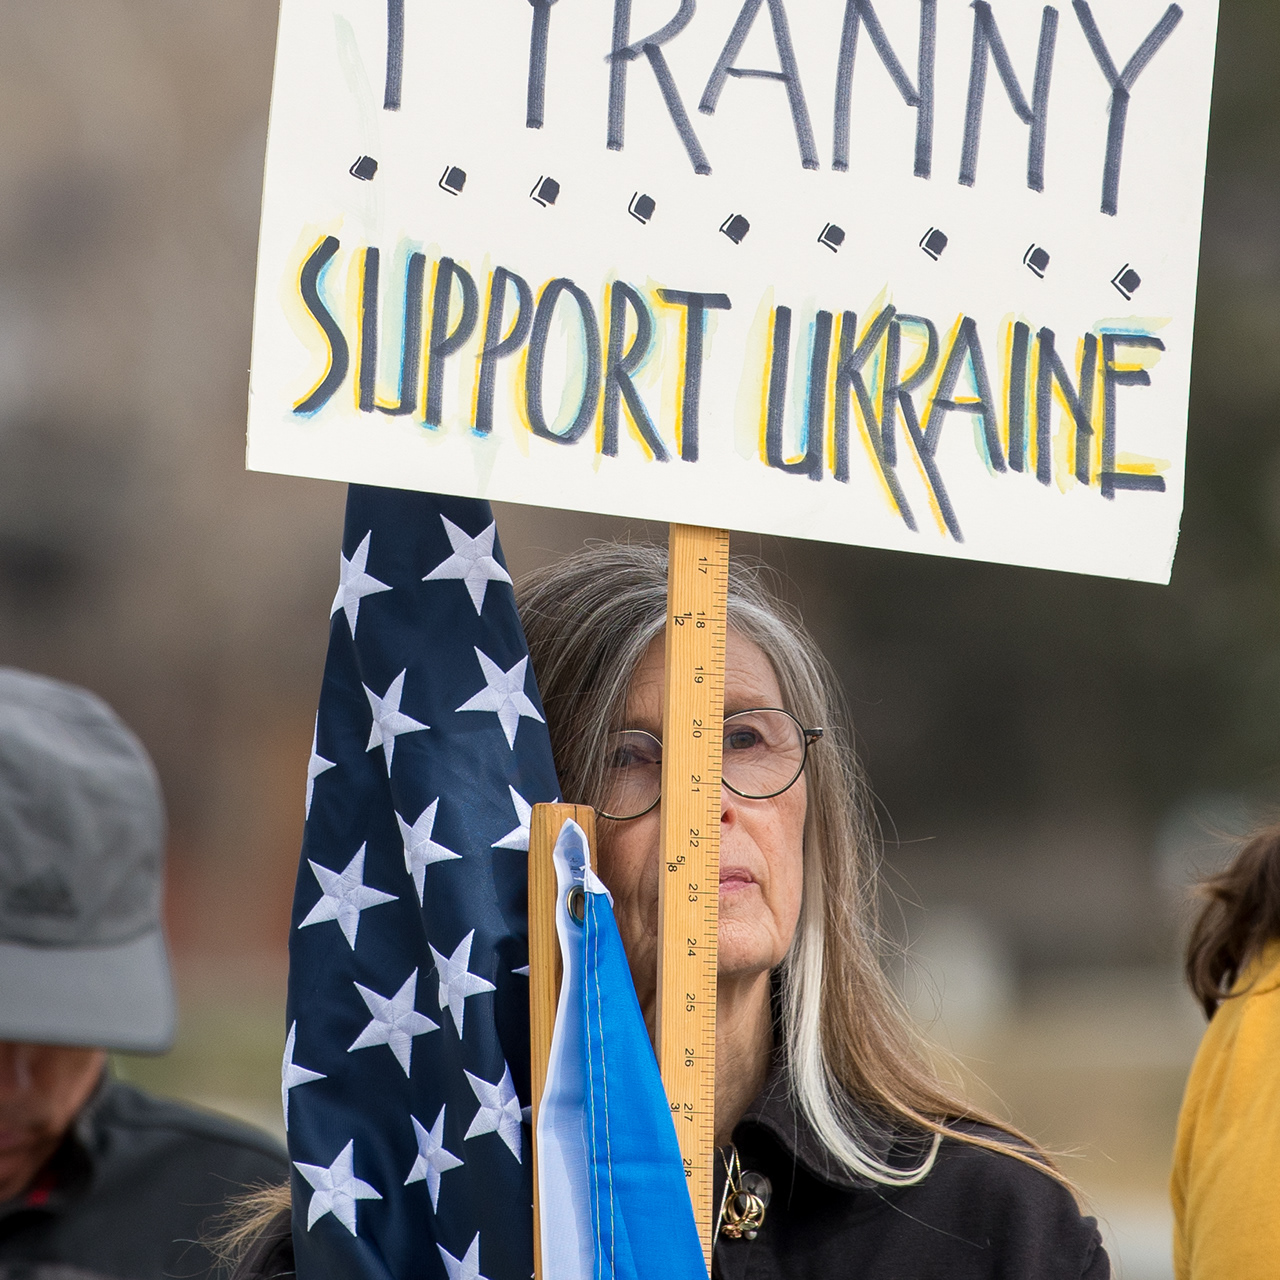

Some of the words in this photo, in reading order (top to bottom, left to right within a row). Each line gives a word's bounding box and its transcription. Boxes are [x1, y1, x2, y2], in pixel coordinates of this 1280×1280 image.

[294, 236, 730, 461] SUPPORT
[767, 305, 1165, 543] UKRAINE
[697, 556, 708, 575] 17
[696, 611, 706, 629] 18
[694, 665, 704, 684] 19
[692, 719, 702, 739] 20
[691, 774, 701, 793] 21
[689, 828, 700, 848] 22
[688, 883, 699, 902] 23
[687, 938, 697, 957] 24
[686, 993, 696, 1012] 25
[684, 1048, 695, 1067] 26
[683, 1103, 693, 1122] 27
